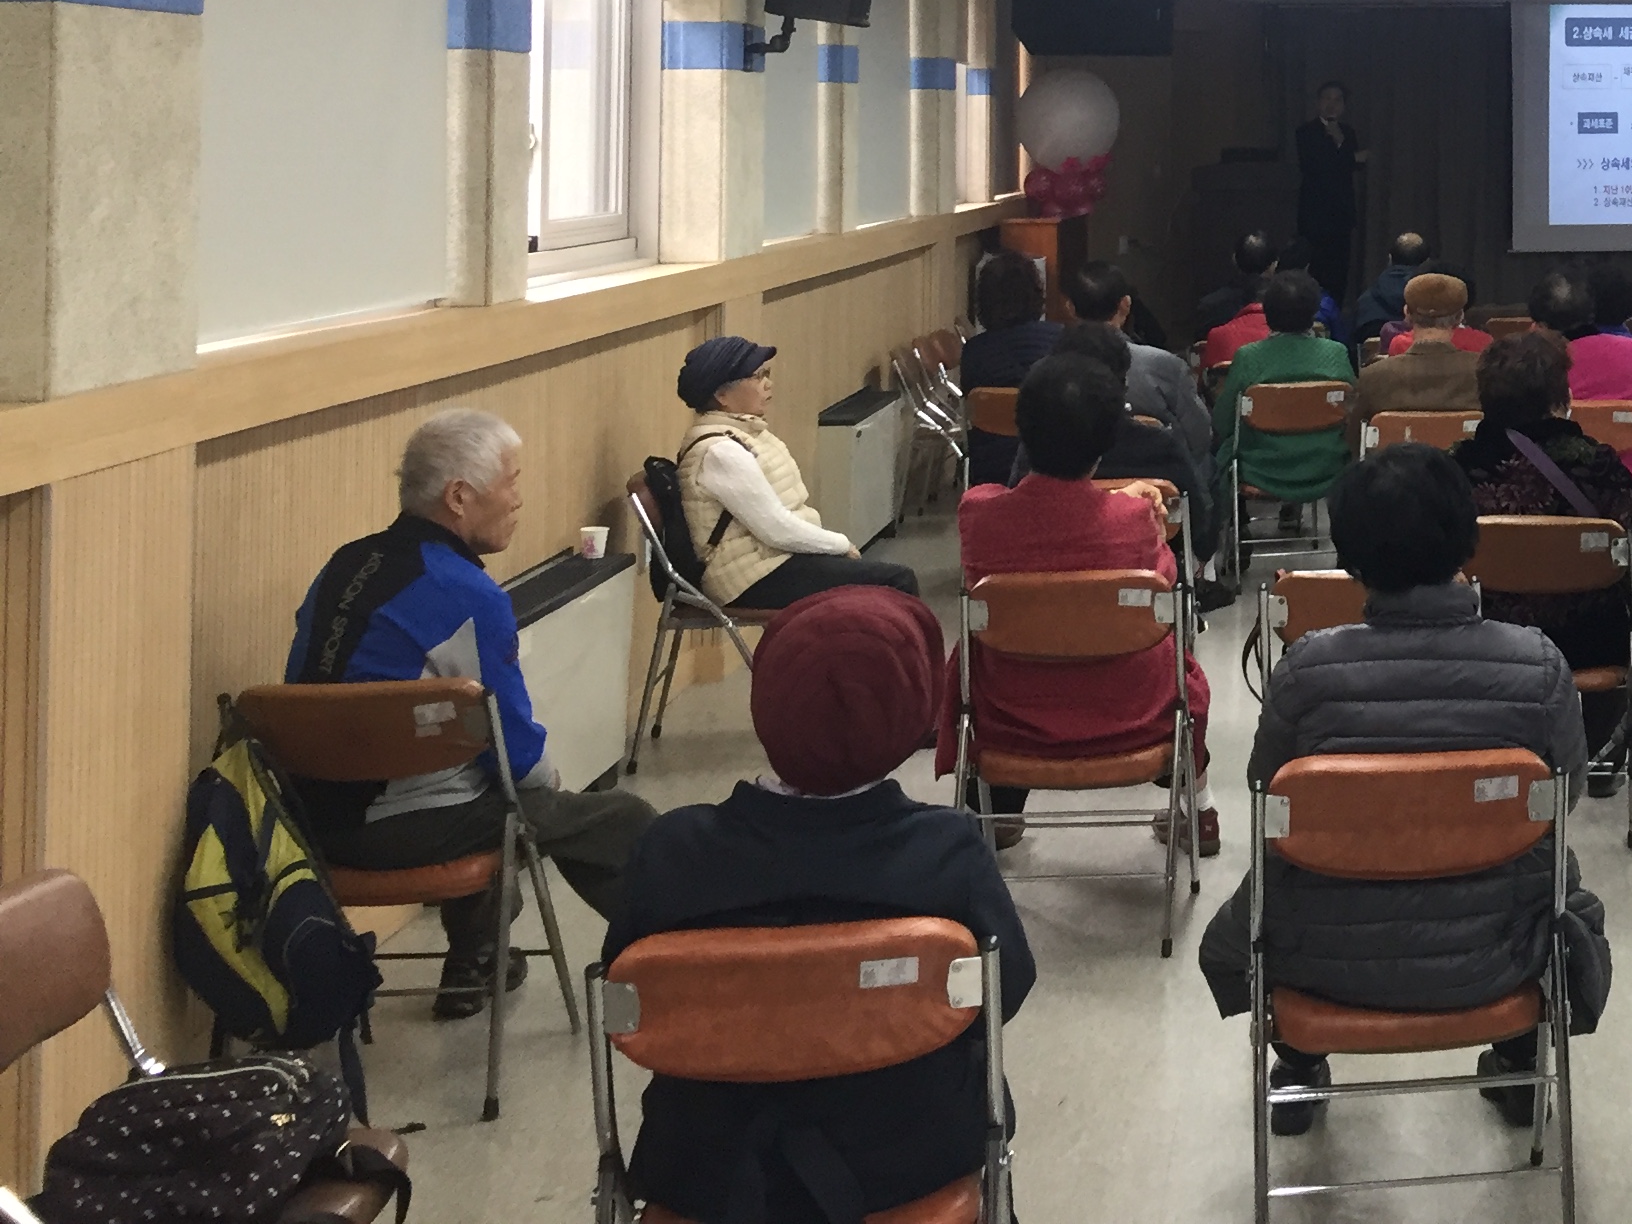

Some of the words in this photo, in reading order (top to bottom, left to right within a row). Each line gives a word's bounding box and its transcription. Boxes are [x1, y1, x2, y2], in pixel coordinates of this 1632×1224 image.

[1572, 26, 1613, 41] 2.상속세
[338, 552, 384, 611] KOLON
[319, 615, 349, 675] SPORT
